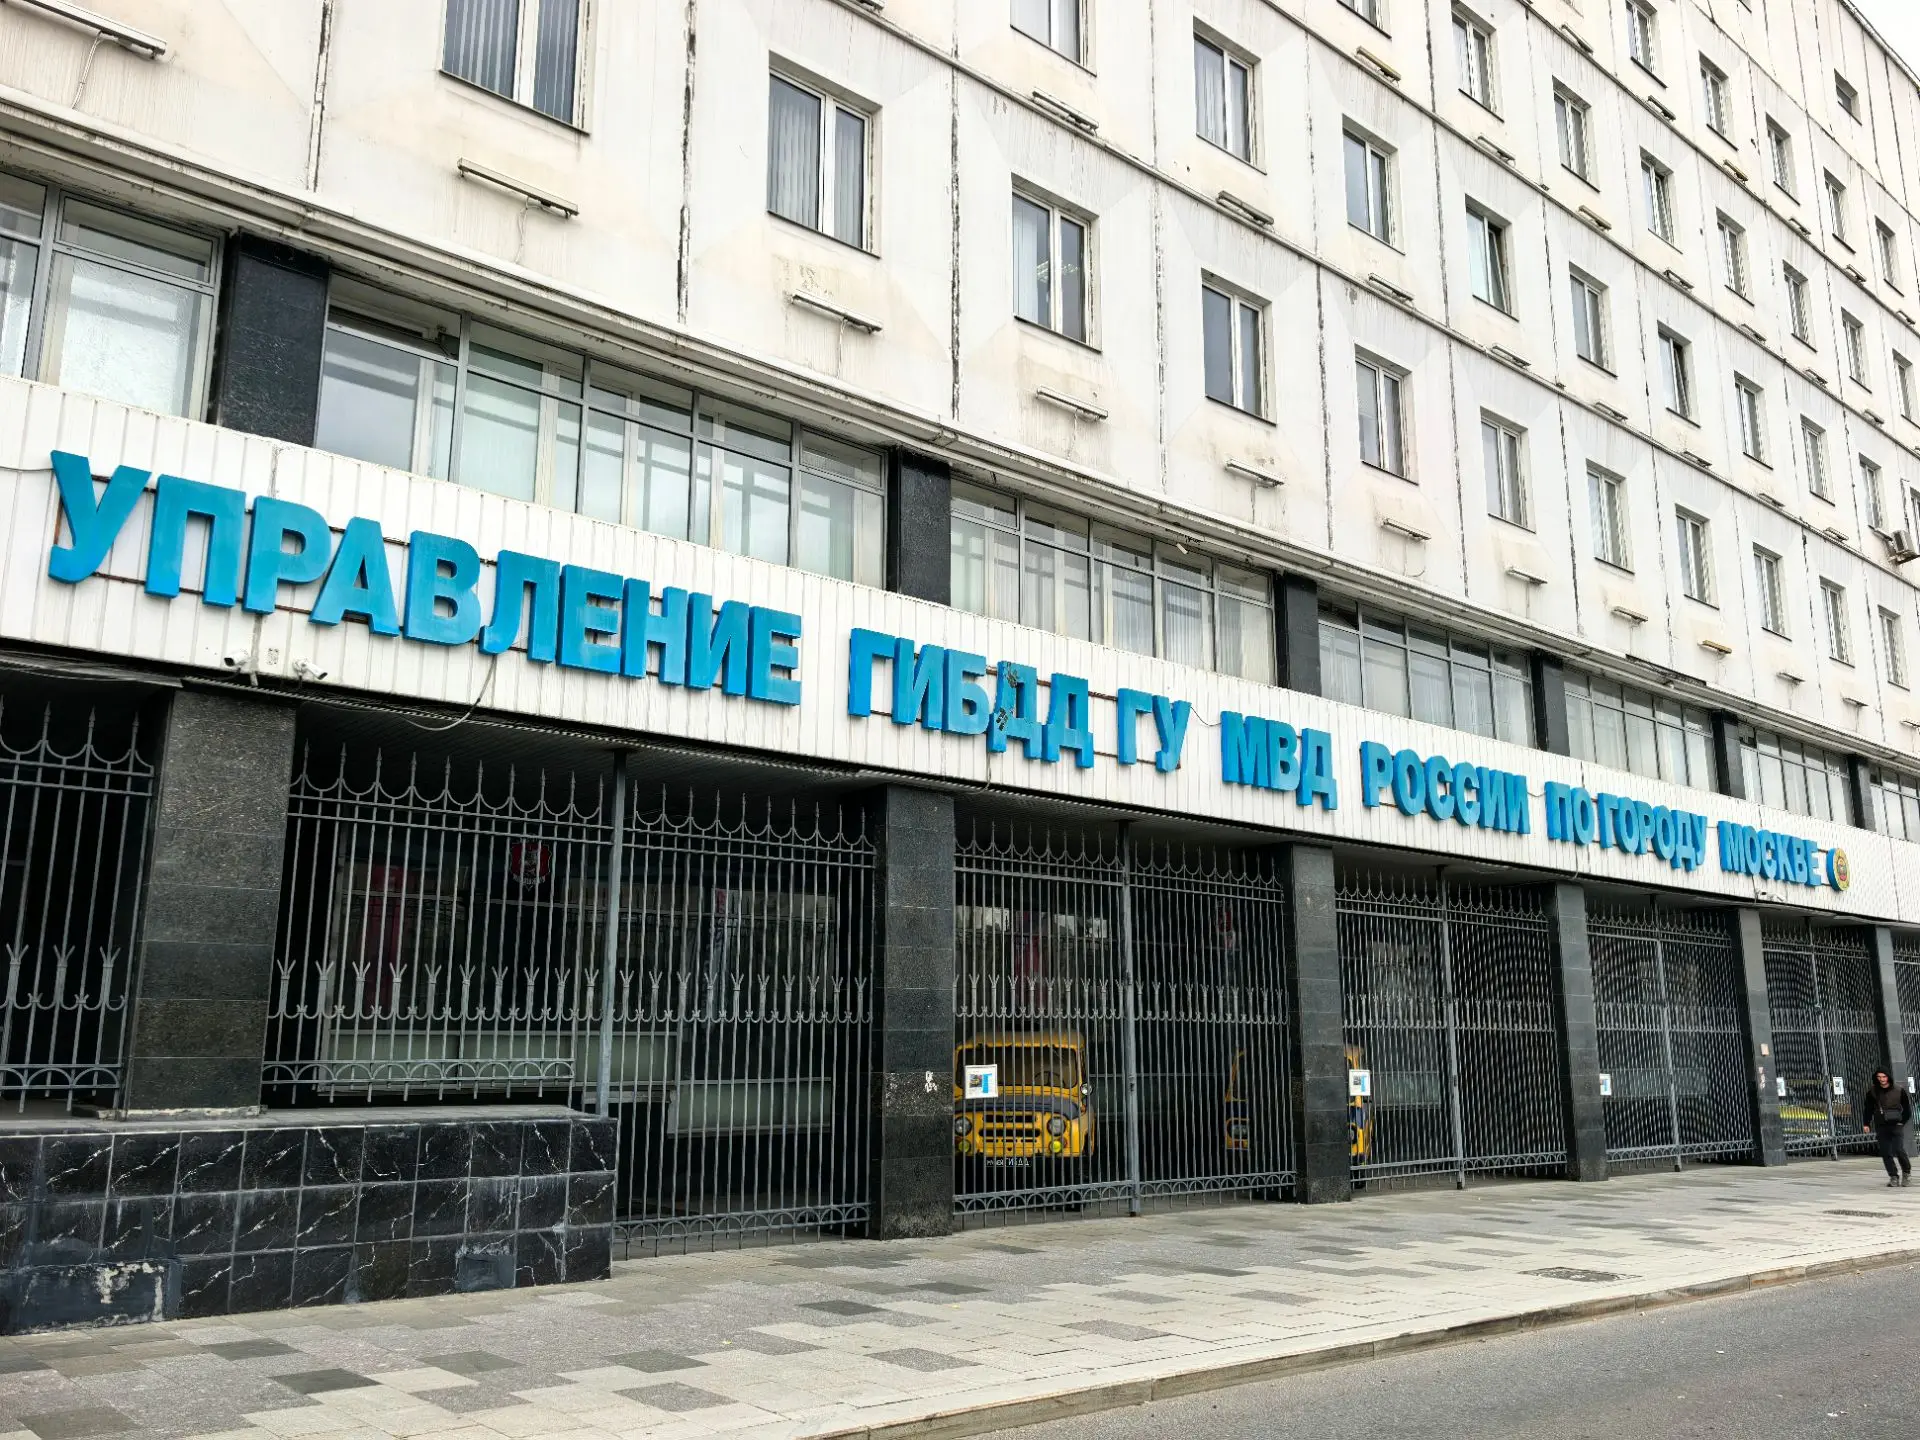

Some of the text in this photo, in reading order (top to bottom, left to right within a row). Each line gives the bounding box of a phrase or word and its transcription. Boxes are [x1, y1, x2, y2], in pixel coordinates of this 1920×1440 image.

[48, 450, 1822, 888] УПРАВЛЕНИЕ ГИБДД ГУ МВД РОССИИ ПО ГОРОДУ МОСКВЕ
